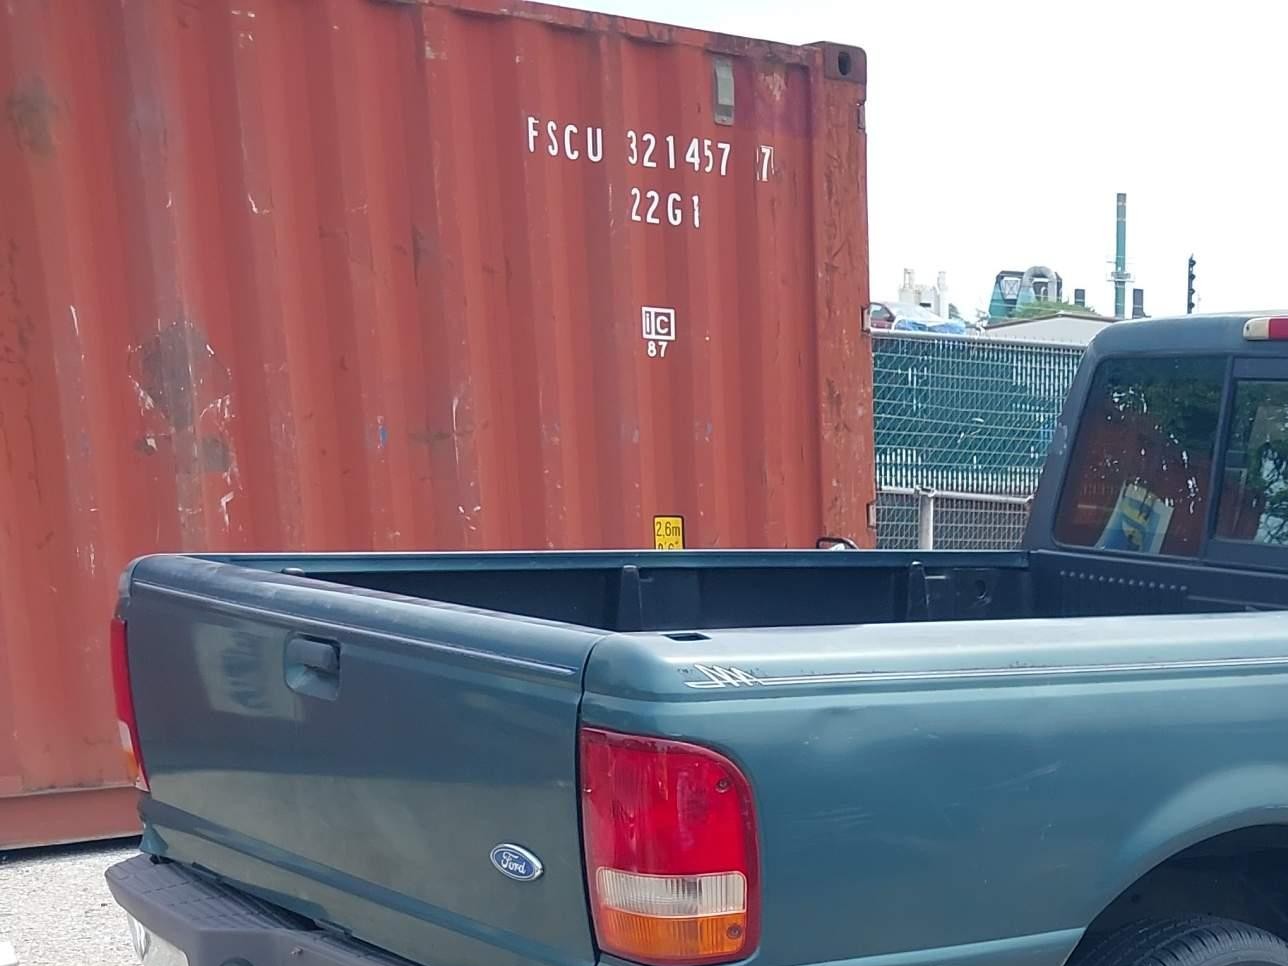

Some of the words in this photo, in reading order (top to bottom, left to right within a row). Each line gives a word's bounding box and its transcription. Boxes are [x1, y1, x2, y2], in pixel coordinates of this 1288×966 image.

[528, 116, 603, 162] FSCU
[626, 130, 731, 176] 321457
[759, 145, 773, 181] 7
[630, 187, 700, 228] 22G1
[647, 340, 668, 358] 87
[655, 521, 681, 539] 2.6m
[501, 851, 526, 874] Ford
